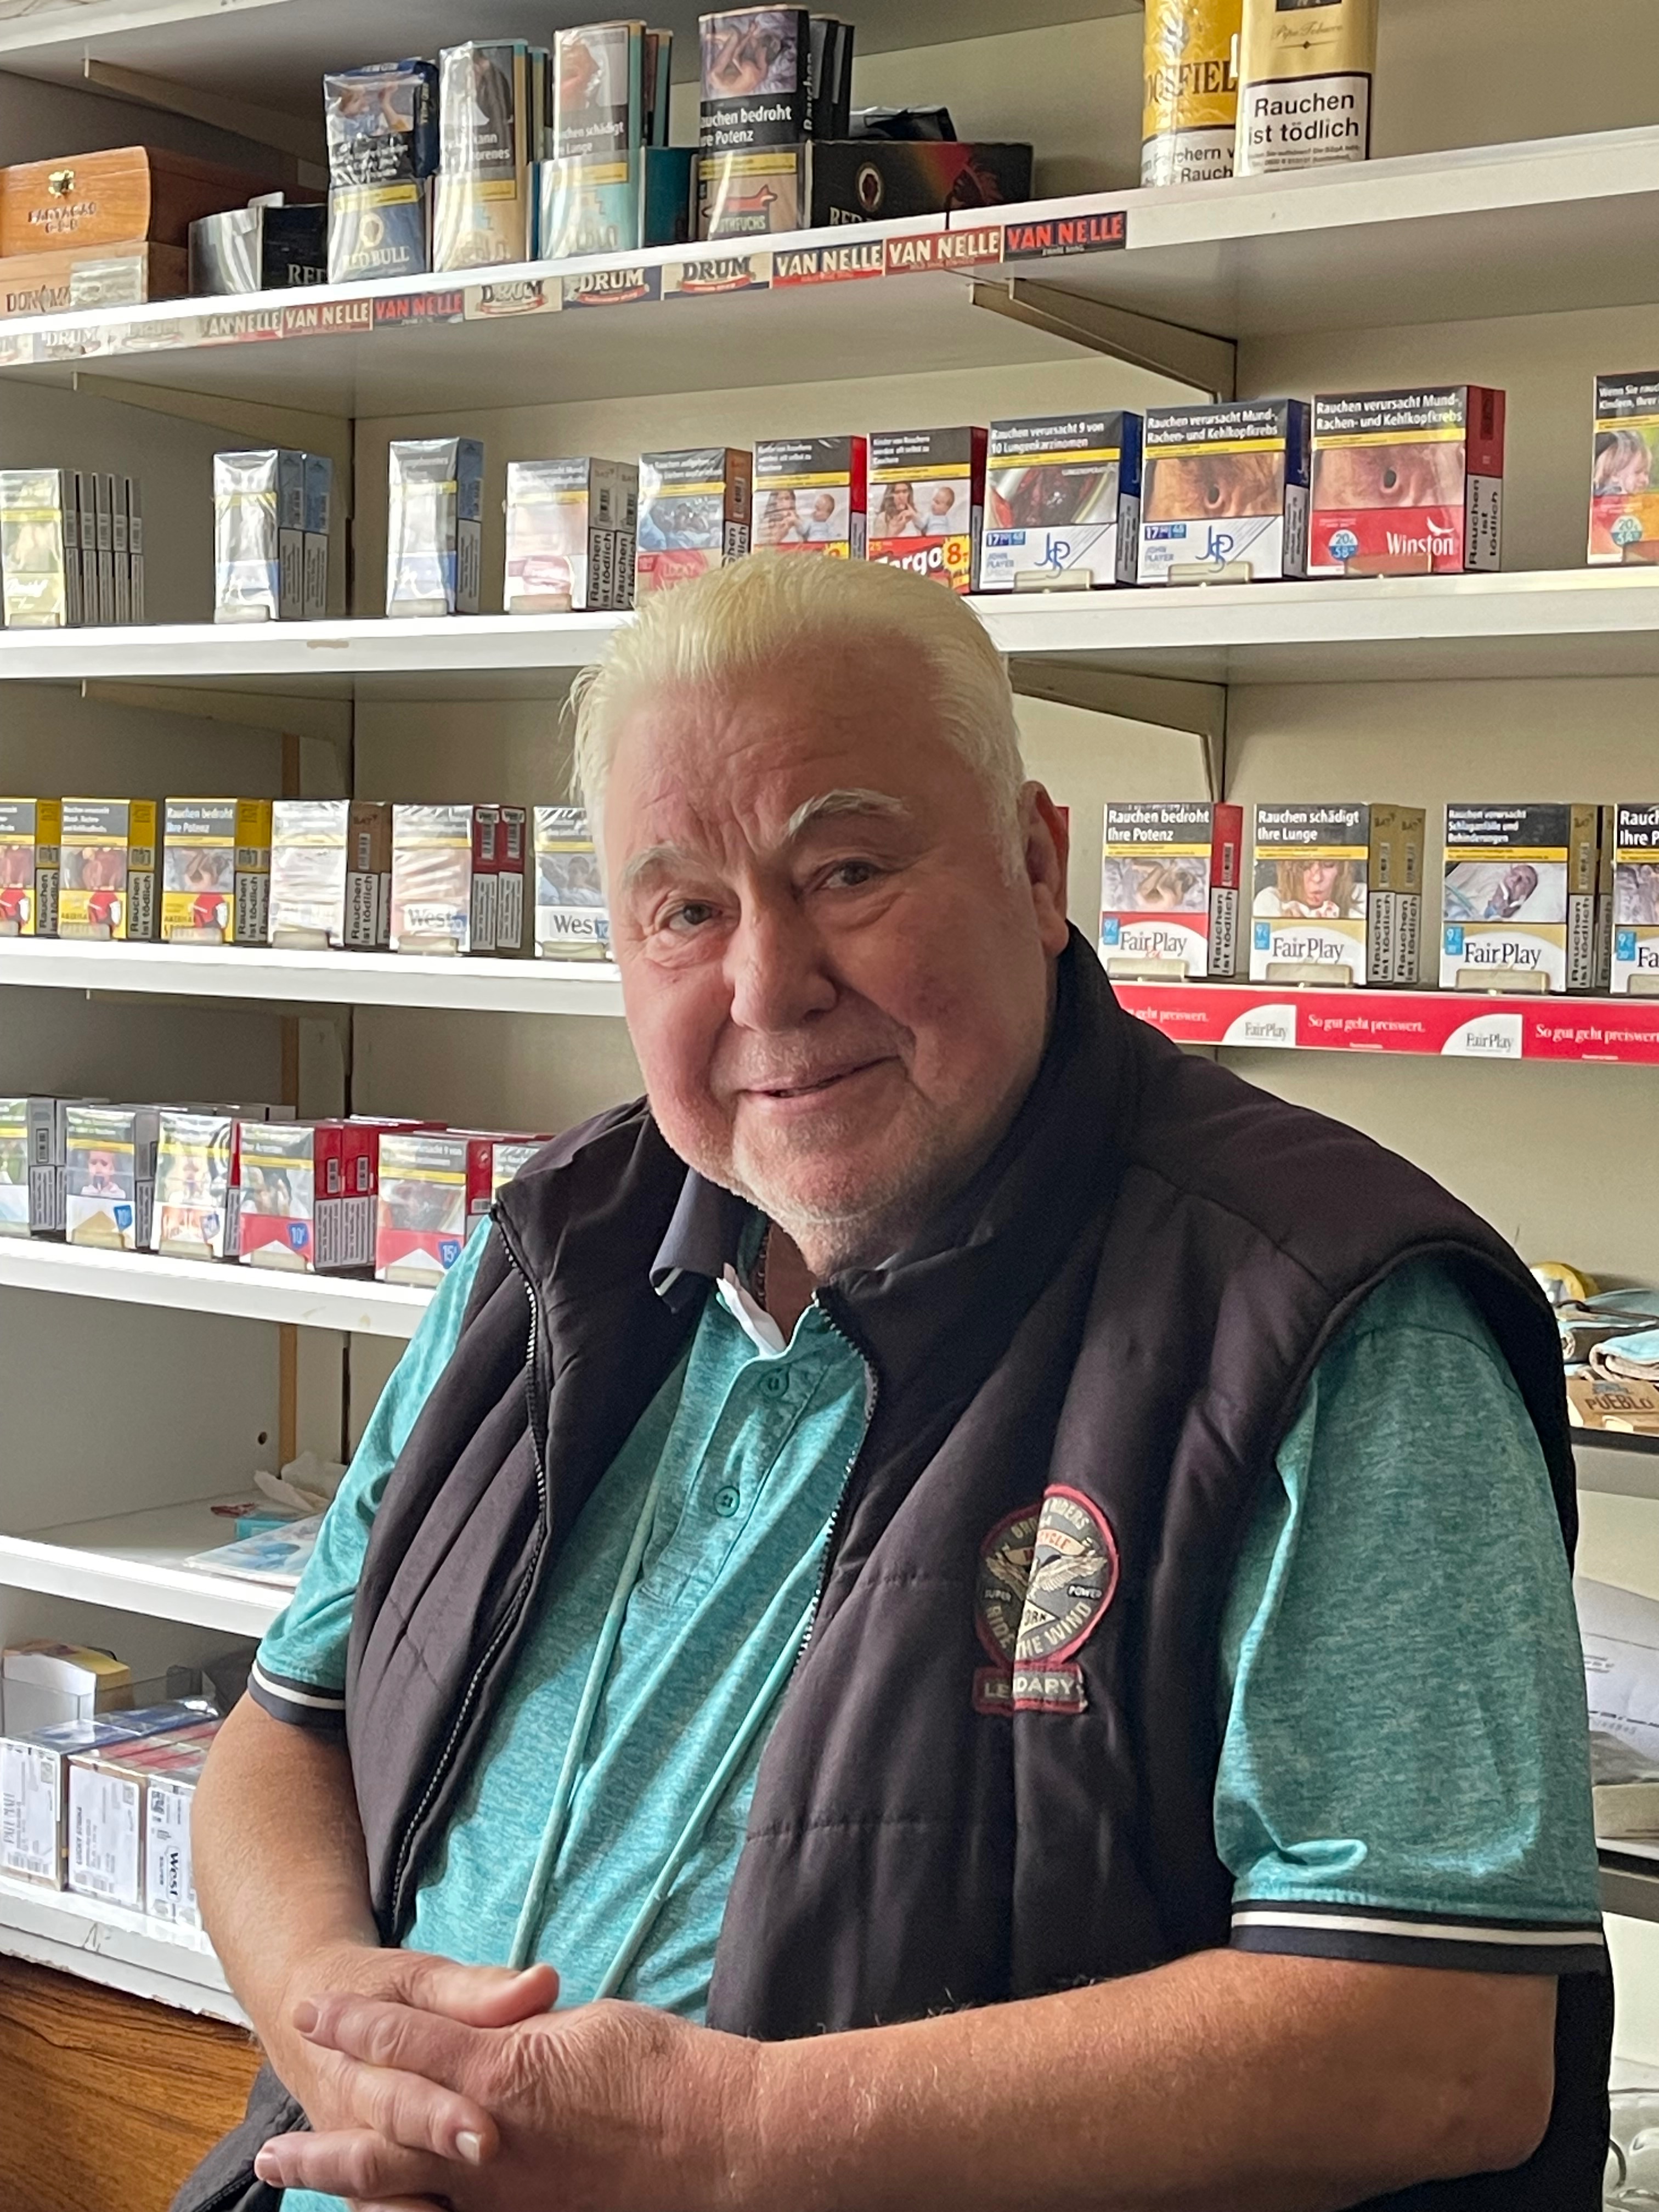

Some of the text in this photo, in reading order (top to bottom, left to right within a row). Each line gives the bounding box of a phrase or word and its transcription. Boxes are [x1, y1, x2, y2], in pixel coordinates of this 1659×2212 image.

[701, 104, 792, 128] auchen bedroht
[1254, 92, 1355, 118] Rauchen
[715, 129, 754, 145] Potenz
[1249, 116, 1359, 146] ist tödlich
[1007, 225, 1052, 251] VAN
[1057, 214, 1124, 245] NELLE
[776, 252, 817, 278] VAN
[823, 245, 882, 272] NELLE
[888, 240, 933, 266] VAN
[937, 231, 999, 259] NELLE
[579, 268, 646, 292] DRUM
[681, 256, 752, 281] DRUM
[286, 306, 317, 329] VAN
[321, 303, 369, 325] NELLE
[374, 298, 409, 319] VAN
[411, 292, 464, 316] NELLE
[1317, 399, 1362, 415] Rauchen
[1364, 394, 1422, 412] verursacht
[991, 422, 1105, 440] Rauchen verursacht 9 von
[1147, 415, 1188, 429] Rauchen
[1189, 411, 1240, 427] verursacht
[1187, 427, 1206, 441] und
[1207, 424, 1278, 439] Kehlkopfkrebs
[1316, 410, 1463, 431] Rachen- und Kehlkopfkrebs
[991, 443, 1002, 454] 10
[1146, 526, 1158, 539] 17
[1469, 479, 1480, 565] Rauchen
[988, 533, 1000, 545] 17
[1386, 530, 1454, 556] Winston
[590, 534, 602, 601] Rauchen
[602, 533, 612, 585] tödlich
[616, 538, 629, 604] Rauchen
[1108, 809, 1210, 823] Rauchen bedroht
[1257, 810, 1360, 826] Rauchen schädigt
[1108, 827, 1174, 841] Ihre Potenz
[1257, 827, 1318, 843] Ihre Lunge
[1620, 829, 1647, 845] Ihre
[39, 874, 48, 928] Rauchen
[130, 877, 140, 932] Rauchen
[142, 875, 151, 918] tödlich
[238, 878, 247, 935] Rauchen
[351, 877, 362, 940] Rauchen
[1120, 930, 1188, 957] FairPlay
[1212, 894, 1223, 969] Rauchen
[1373, 898, 1382, 975] Rauchen
[1397, 900, 1408, 976] Rauchen
[1572, 901, 1581, 981] Rauchen
[1272, 936, 1345, 964] FairPlay
[1464, 941, 1542, 970] FairPlay
[1245, 1022, 1288, 1041] FairPlay
[1308, 1014, 1425, 1033] So gut geht preiswert.
[1536, 1024, 1551, 1038] So
[1553, 1028, 1574, 1042] gut
[1576, 1027, 1603, 1042] geht
[1466, 1032, 1514, 1052] FairPlay
[1584, 1394, 1655, 1410] PUEBLO
[985, 1605, 1015, 1649] RIDE
[1045, 1601, 1092, 1646] WIND
[169, 1852, 179, 1897] West
